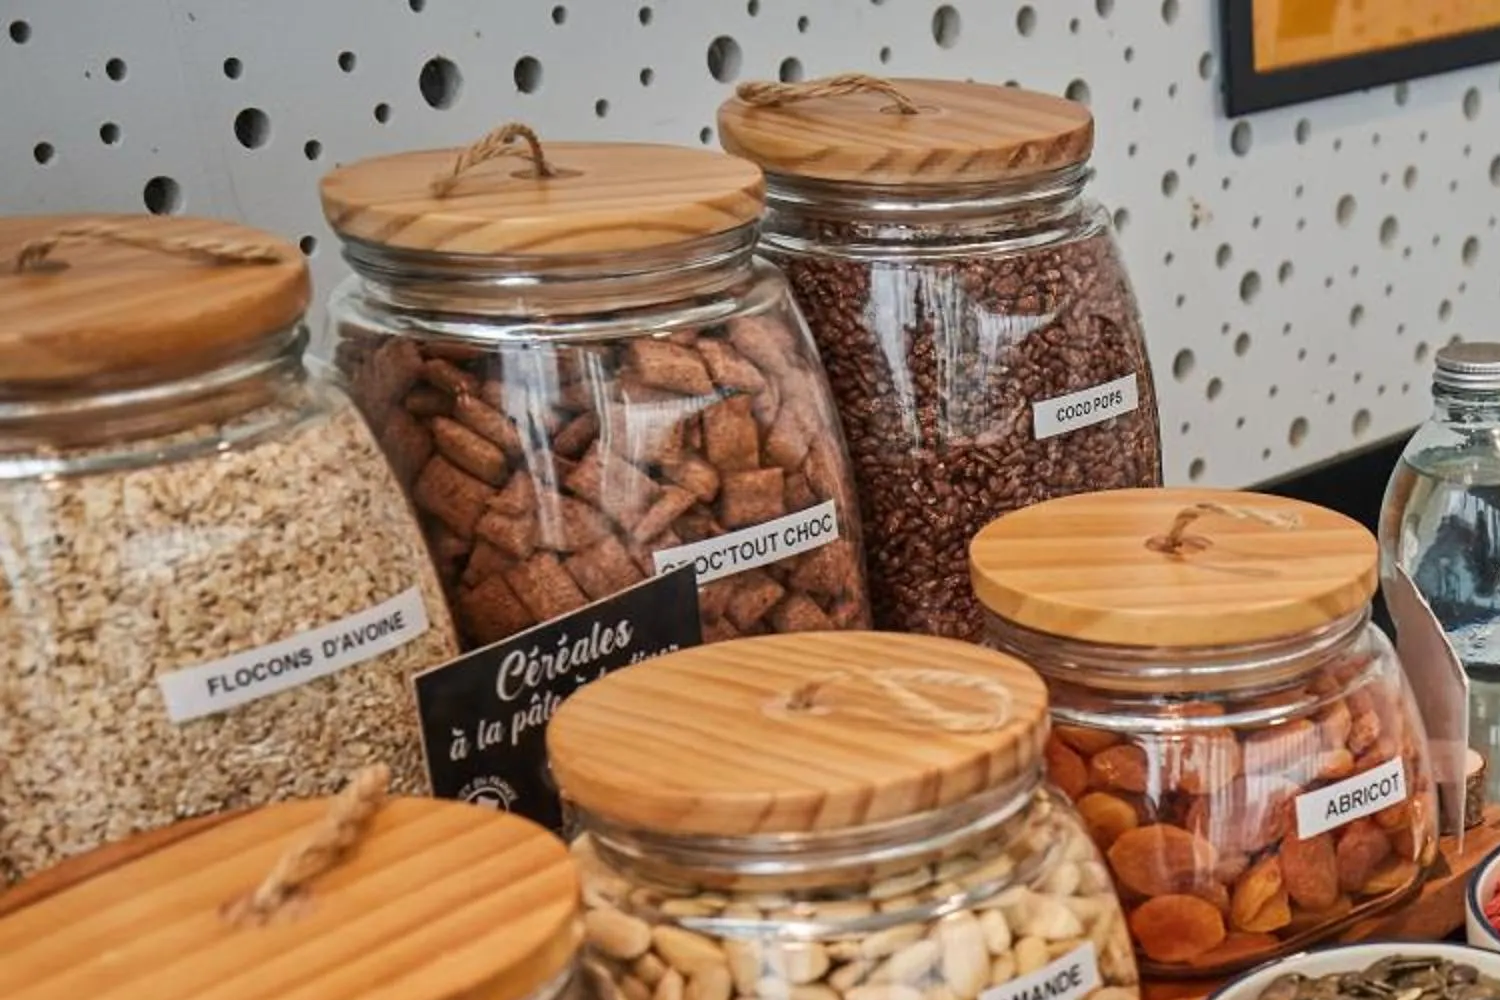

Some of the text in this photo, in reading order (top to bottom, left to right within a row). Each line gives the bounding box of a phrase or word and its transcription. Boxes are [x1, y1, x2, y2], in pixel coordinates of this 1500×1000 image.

[1056, 390, 1123, 422] COCO POPS
[661, 513, 832, 575] OC'TOUT CHOC
[207, 611, 406, 697] FLOCONS D'AVOINE
[495, 620, 635, 701] Céréales
[450, 727, 470, 761] à
[477, 719, 503, 750] la
[1325, 771, 1399, 820] ABRICOT
